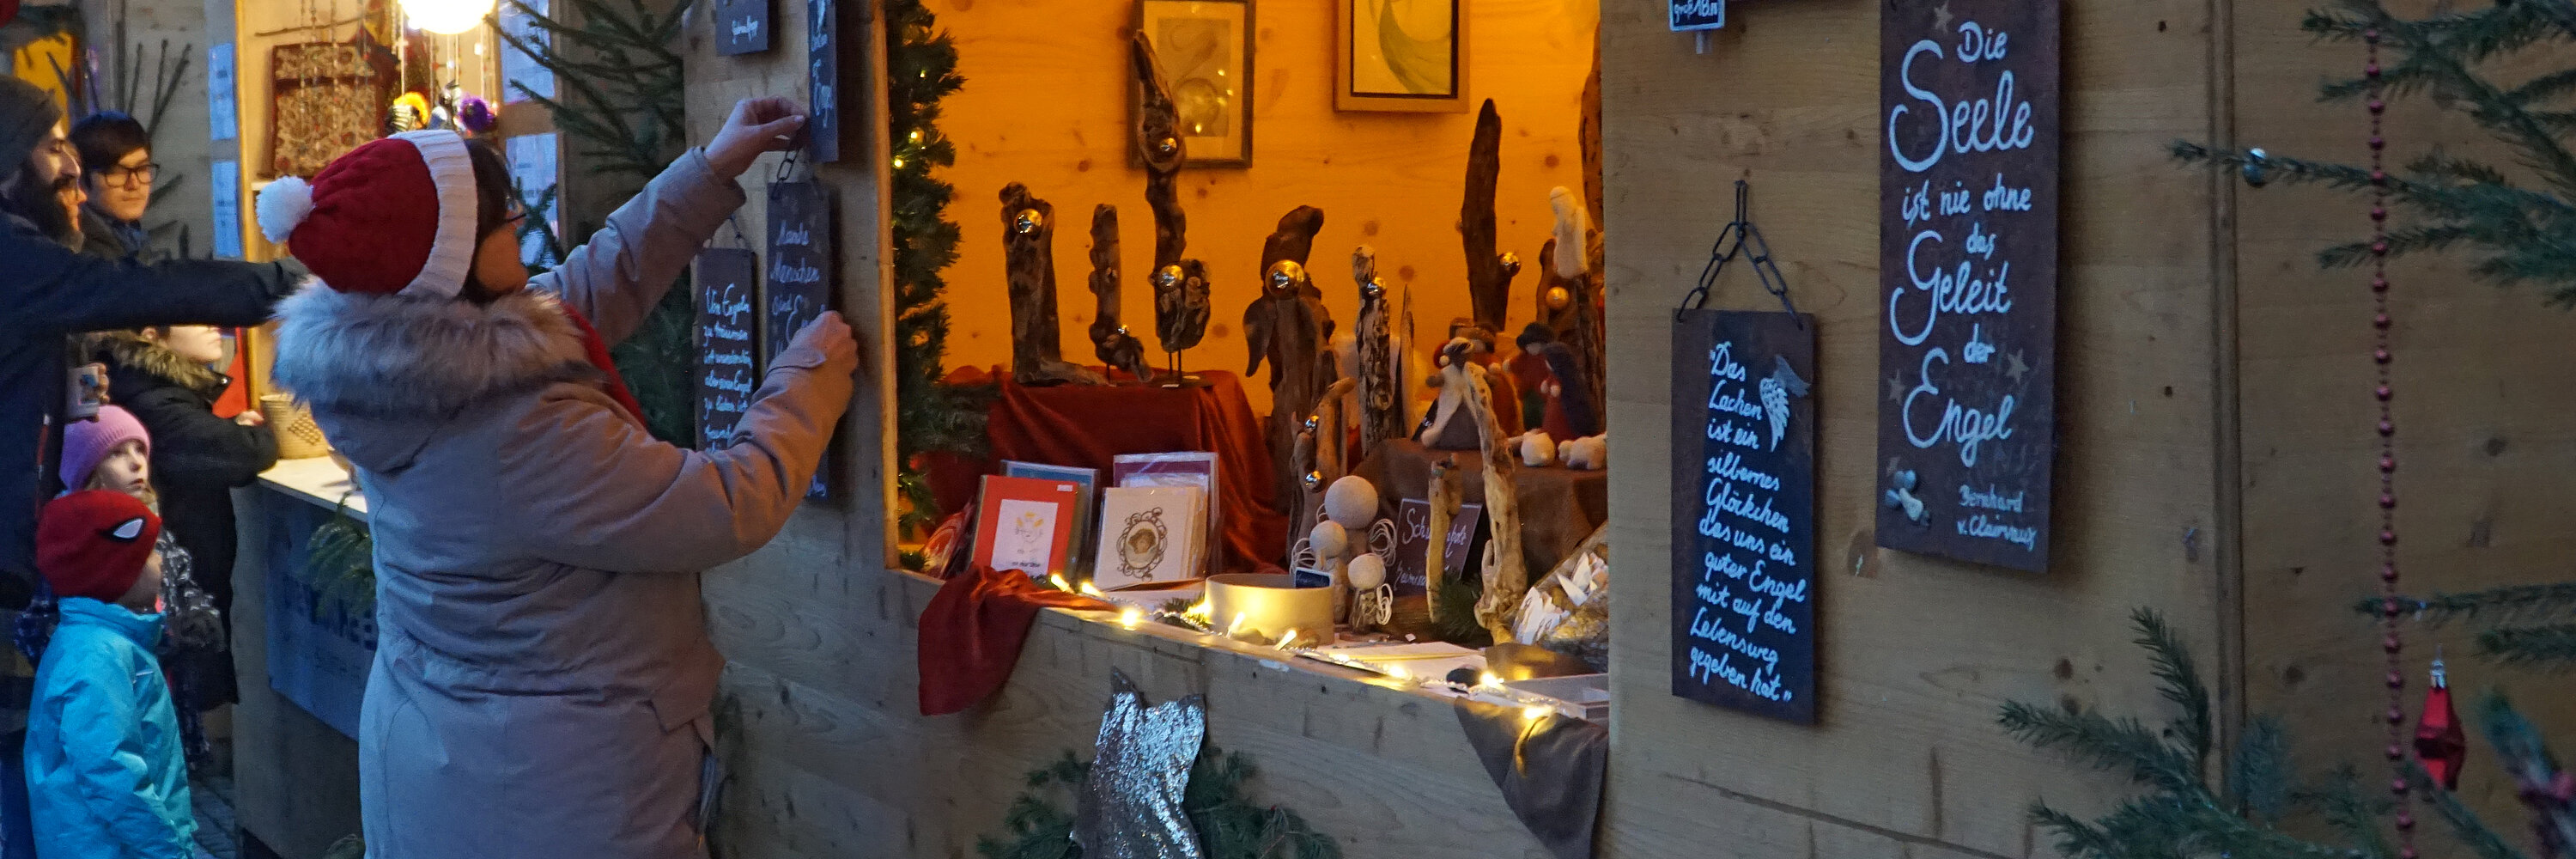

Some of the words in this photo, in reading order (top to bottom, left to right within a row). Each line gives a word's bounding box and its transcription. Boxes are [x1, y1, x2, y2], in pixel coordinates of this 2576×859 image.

[1957, 21, 2008, 63] Die
[1889, 40, 2034, 172] Seele
[1902, 180, 1931, 228] ist
[1940, 180, 1971, 216] nie
[1984, 173, 2032, 211] ohne
[1965, 222, 1996, 260] das
[1890, 229, 2012, 346] Geleit
[1964, 323, 1996, 363] der
[1709, 380, 1762, 420] Lachen
[1903, 347, 2014, 468] Engel
[1707, 417, 1732, 443] ist
[1733, 422, 1759, 450] ein
[1707, 448, 1780, 491] silbernes
[1706, 477, 1789, 533] Glöckchen
[1699, 509, 1731, 543] das
[1734, 529, 1765, 554] uns
[1769, 539, 1796, 567] ein
[1704, 551, 1747, 582] guter
[1749, 559, 1806, 611] Engel
[1696, 582, 1730, 608] mit
[1733, 599, 1762, 634] auf
[1764, 604, 1796, 635] den
[1690, 606, 1779, 677] Lebensweg
[1690, 646, 1747, 685] gegeben
